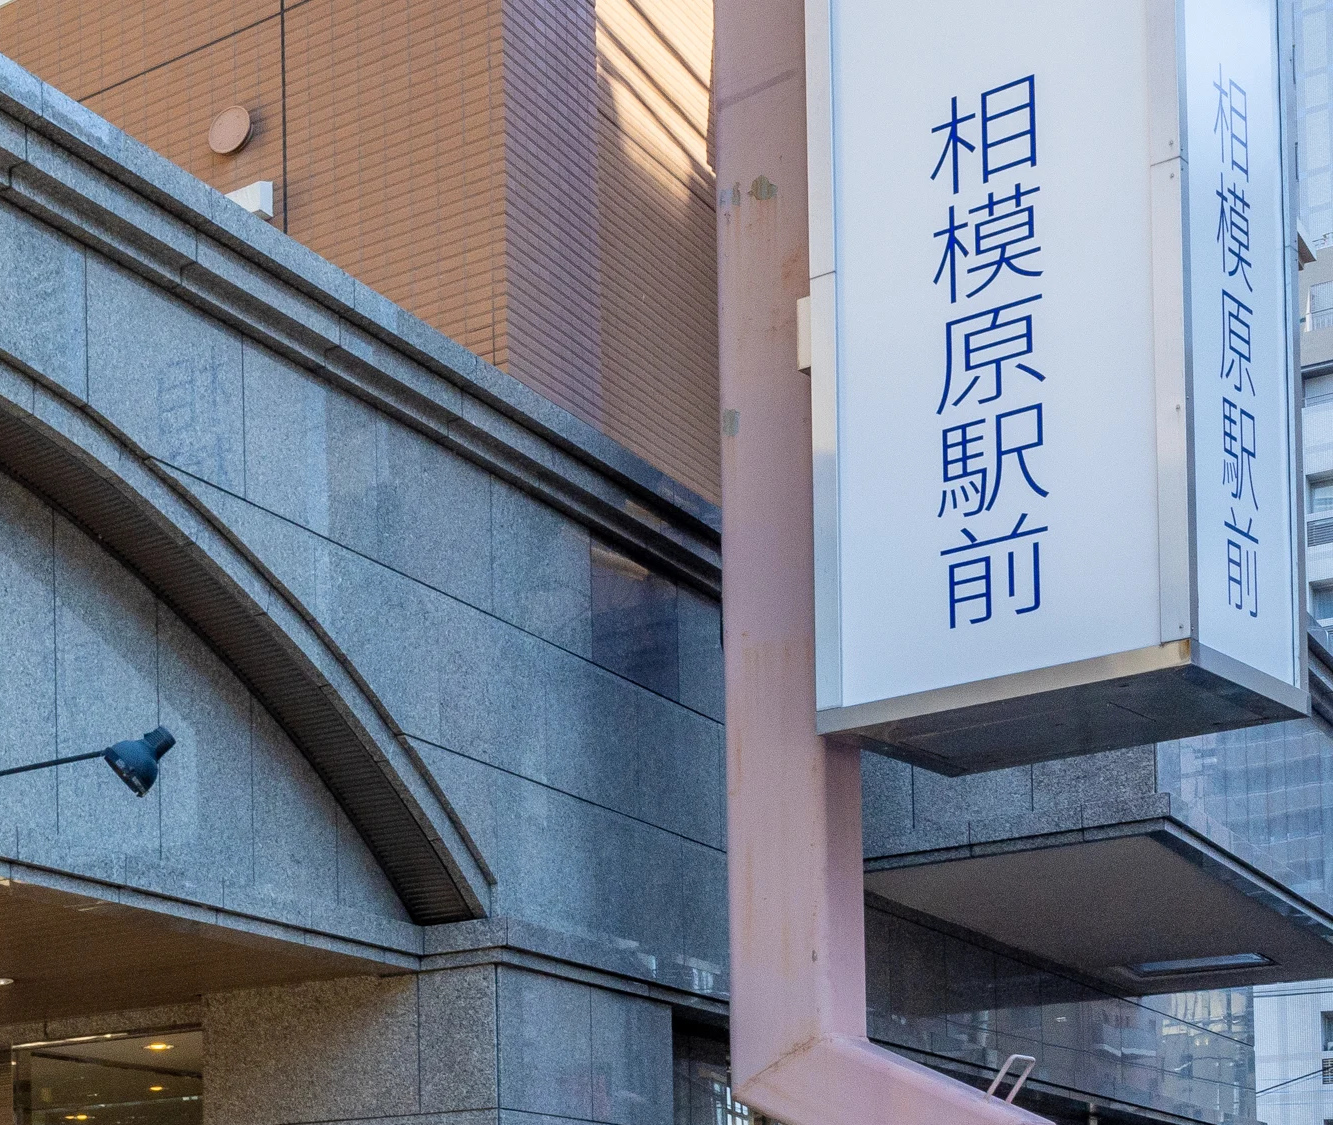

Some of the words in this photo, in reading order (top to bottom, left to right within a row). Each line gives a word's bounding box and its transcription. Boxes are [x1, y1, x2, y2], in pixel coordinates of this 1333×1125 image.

[929, 73, 1050, 630] 相模原駅前
[1213, 62, 1260, 619] 相模原駅前
